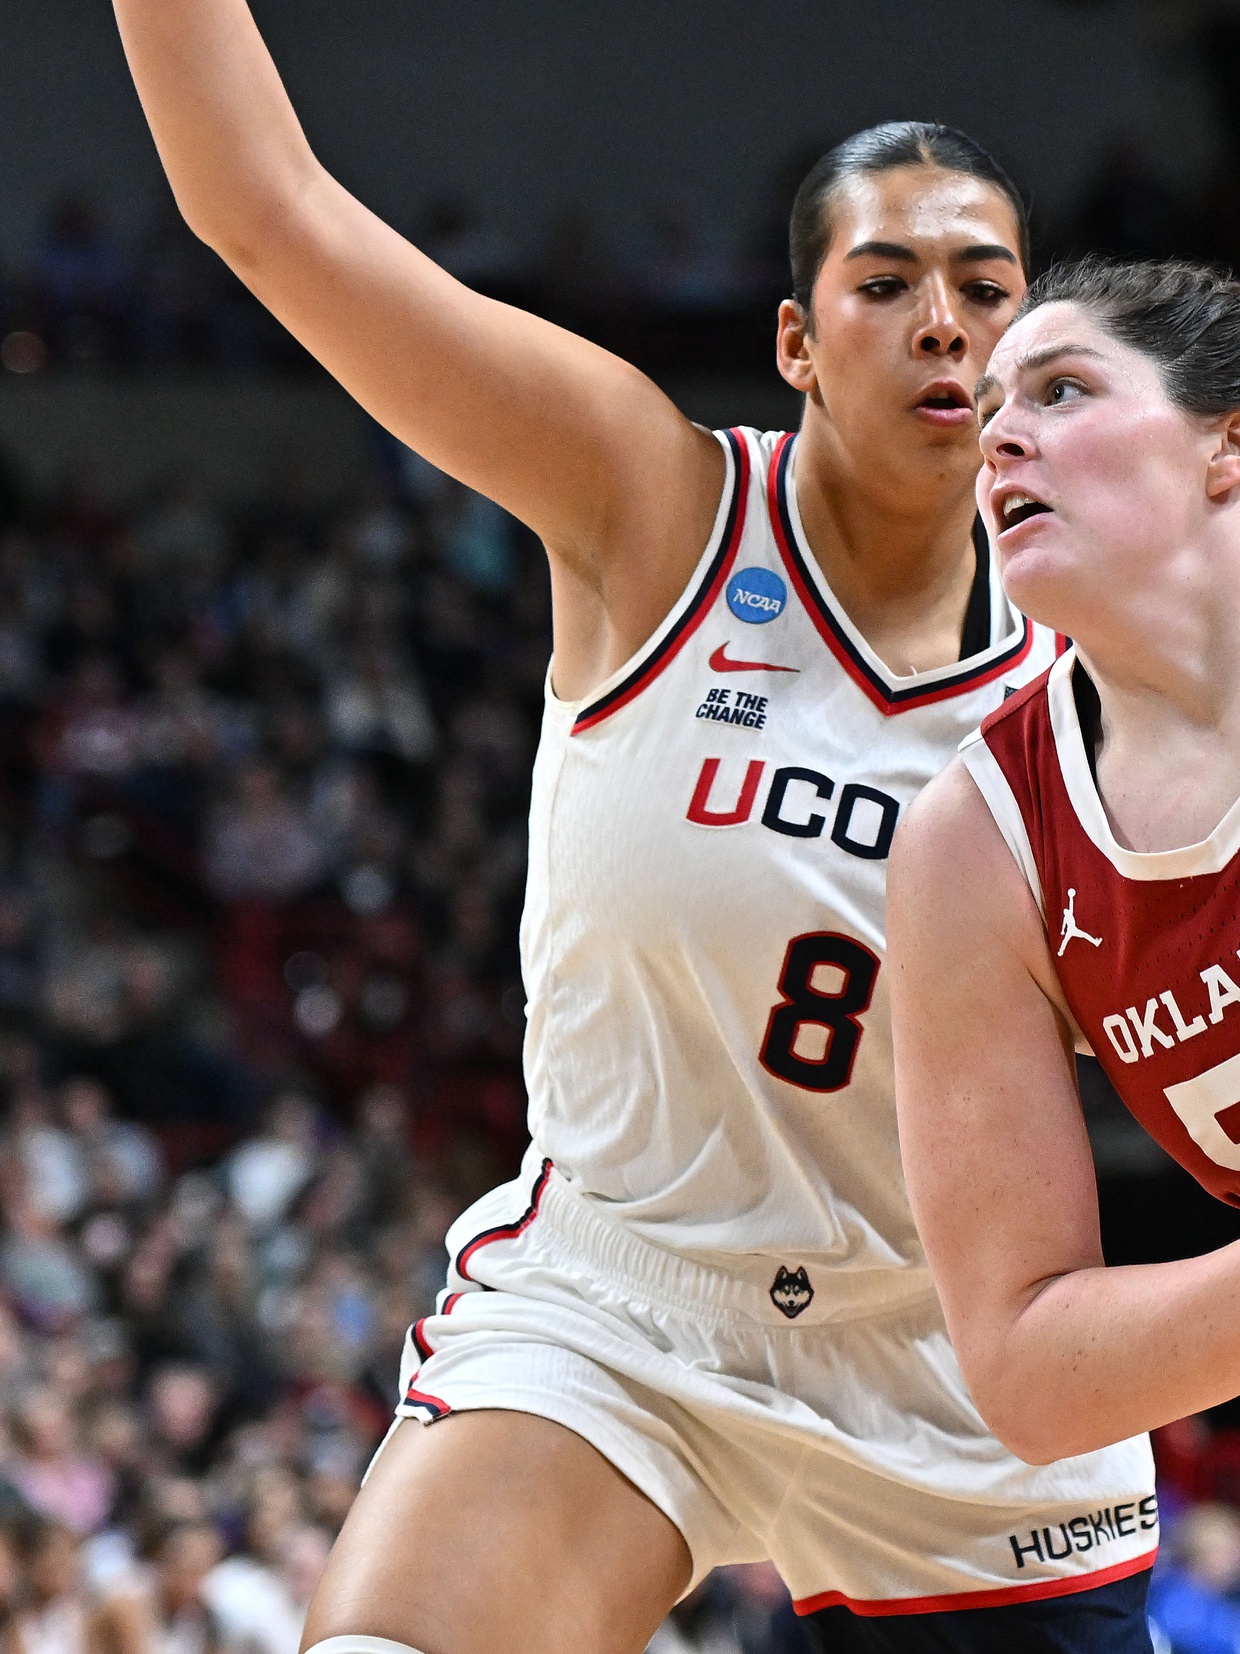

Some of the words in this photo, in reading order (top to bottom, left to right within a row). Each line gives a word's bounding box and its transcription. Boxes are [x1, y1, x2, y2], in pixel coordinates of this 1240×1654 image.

[733, 588, 782, 614] NCAA
[695, 703, 767, 730] CHANGE
[705, 688, 731, 704] BE
[735, 691, 768, 713] THE
[686, 757, 900, 860] UCO
[758, 930, 881, 1093] 8
[1009, 1494, 1159, 1569] HUSKIES
